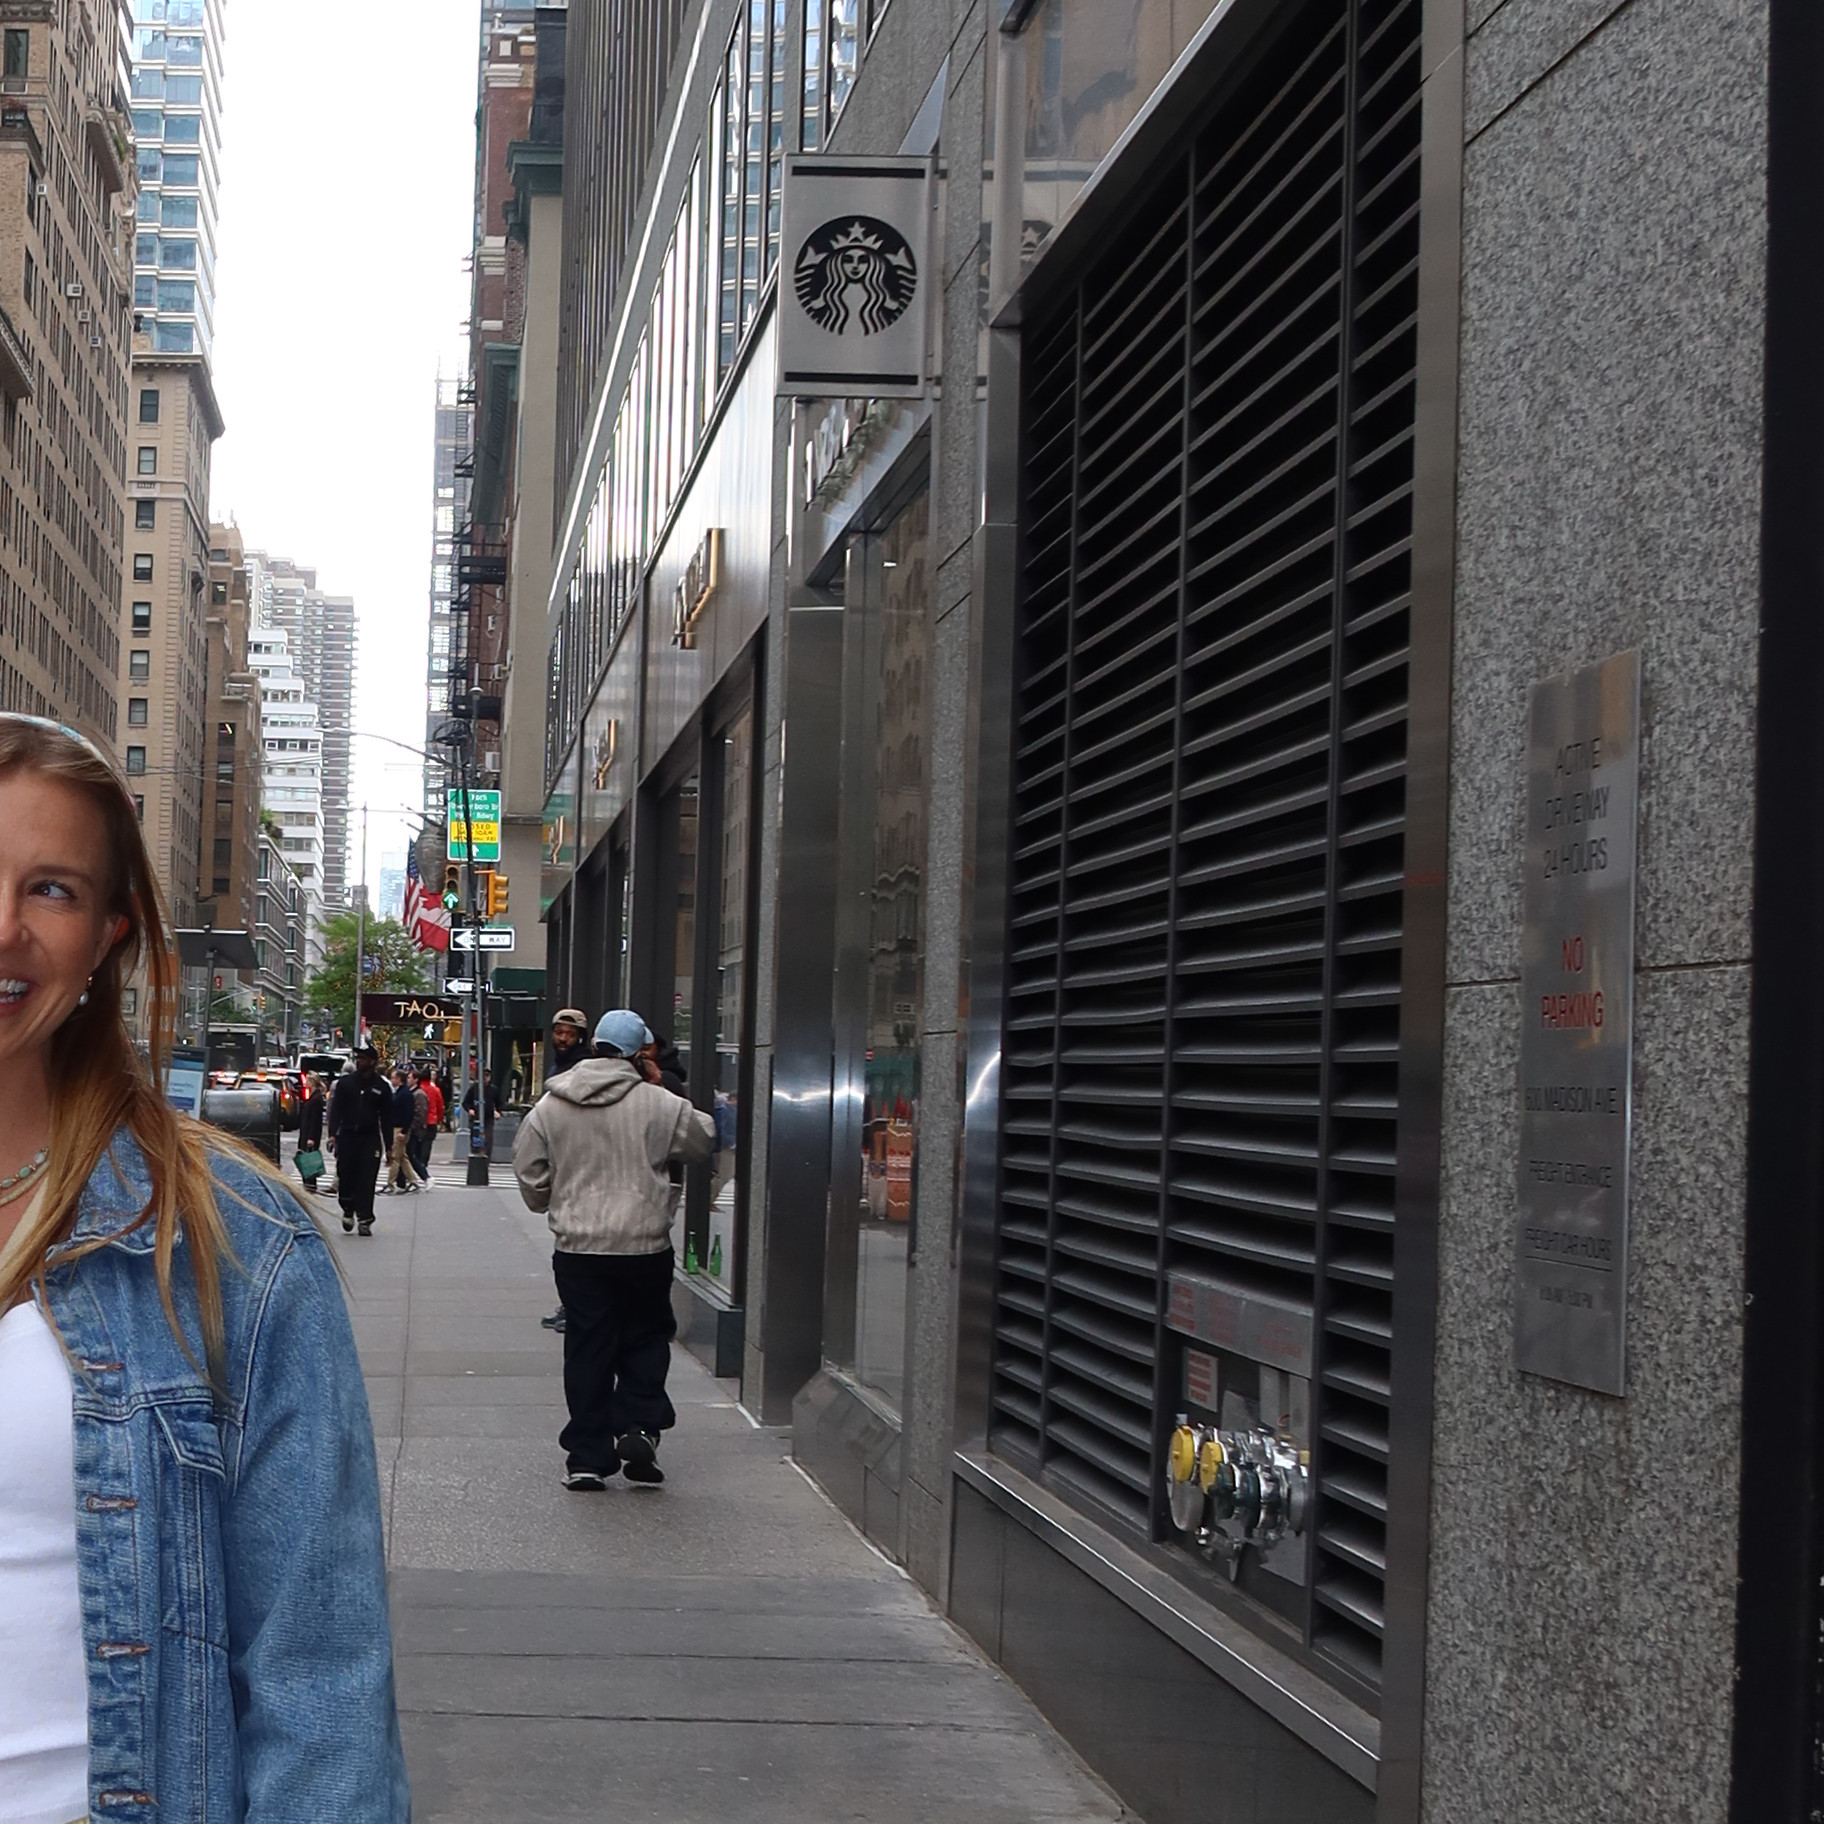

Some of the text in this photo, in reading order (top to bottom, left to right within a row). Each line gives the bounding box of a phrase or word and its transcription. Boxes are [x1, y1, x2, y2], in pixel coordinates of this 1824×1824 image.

[1556, 738, 1601, 776] ACTIVE
[1545, 786, 1610, 830] DRIVEWAY
[1544, 837, 1607, 878] 24 HOURS
[1562, 936, 1584, 973] NO
[394, 1000, 439, 1019] TAO
[1542, 991, 1604, 1028] PARKING
[1544, 1087, 1592, 1113] MADISON
[1581, 1235, 1612, 1261] HOURS
